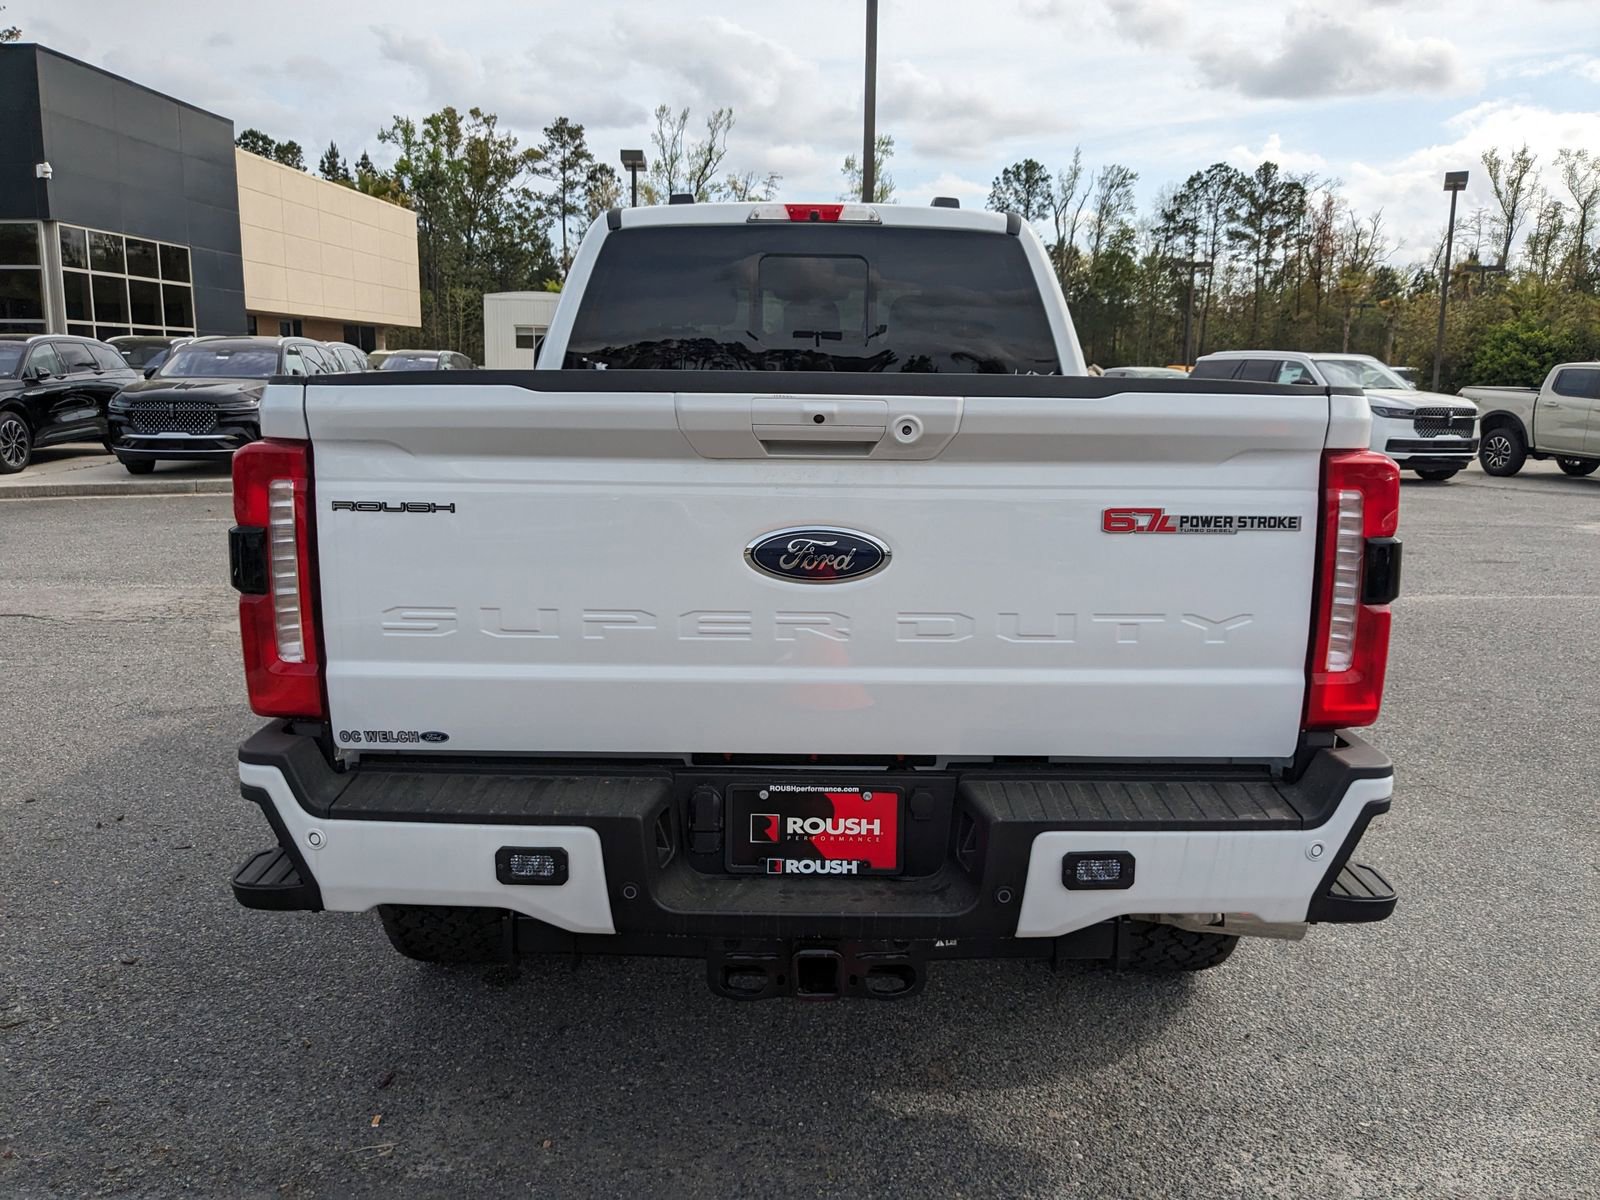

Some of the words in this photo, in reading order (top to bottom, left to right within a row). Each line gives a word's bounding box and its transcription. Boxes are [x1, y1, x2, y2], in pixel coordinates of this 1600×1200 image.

[332, 501, 455, 513] ROUSH
[1179, 516, 1234, 528] POWER
[1237, 516, 1298, 529] STROKE
[779, 538, 856, 570] Ford
[382, 606, 850, 642] SUPER
[896, 612, 1254, 644] DUTY
[339, 730, 361, 742] OC
[363, 730, 420, 743] WELCH
[769, 785, 860, 793] ROUSHperformance.com
[786, 817, 881, 836] ROUSH
[786, 835, 881, 843] PERFORMANCE
[785, 859, 858, 875] ROUSH
